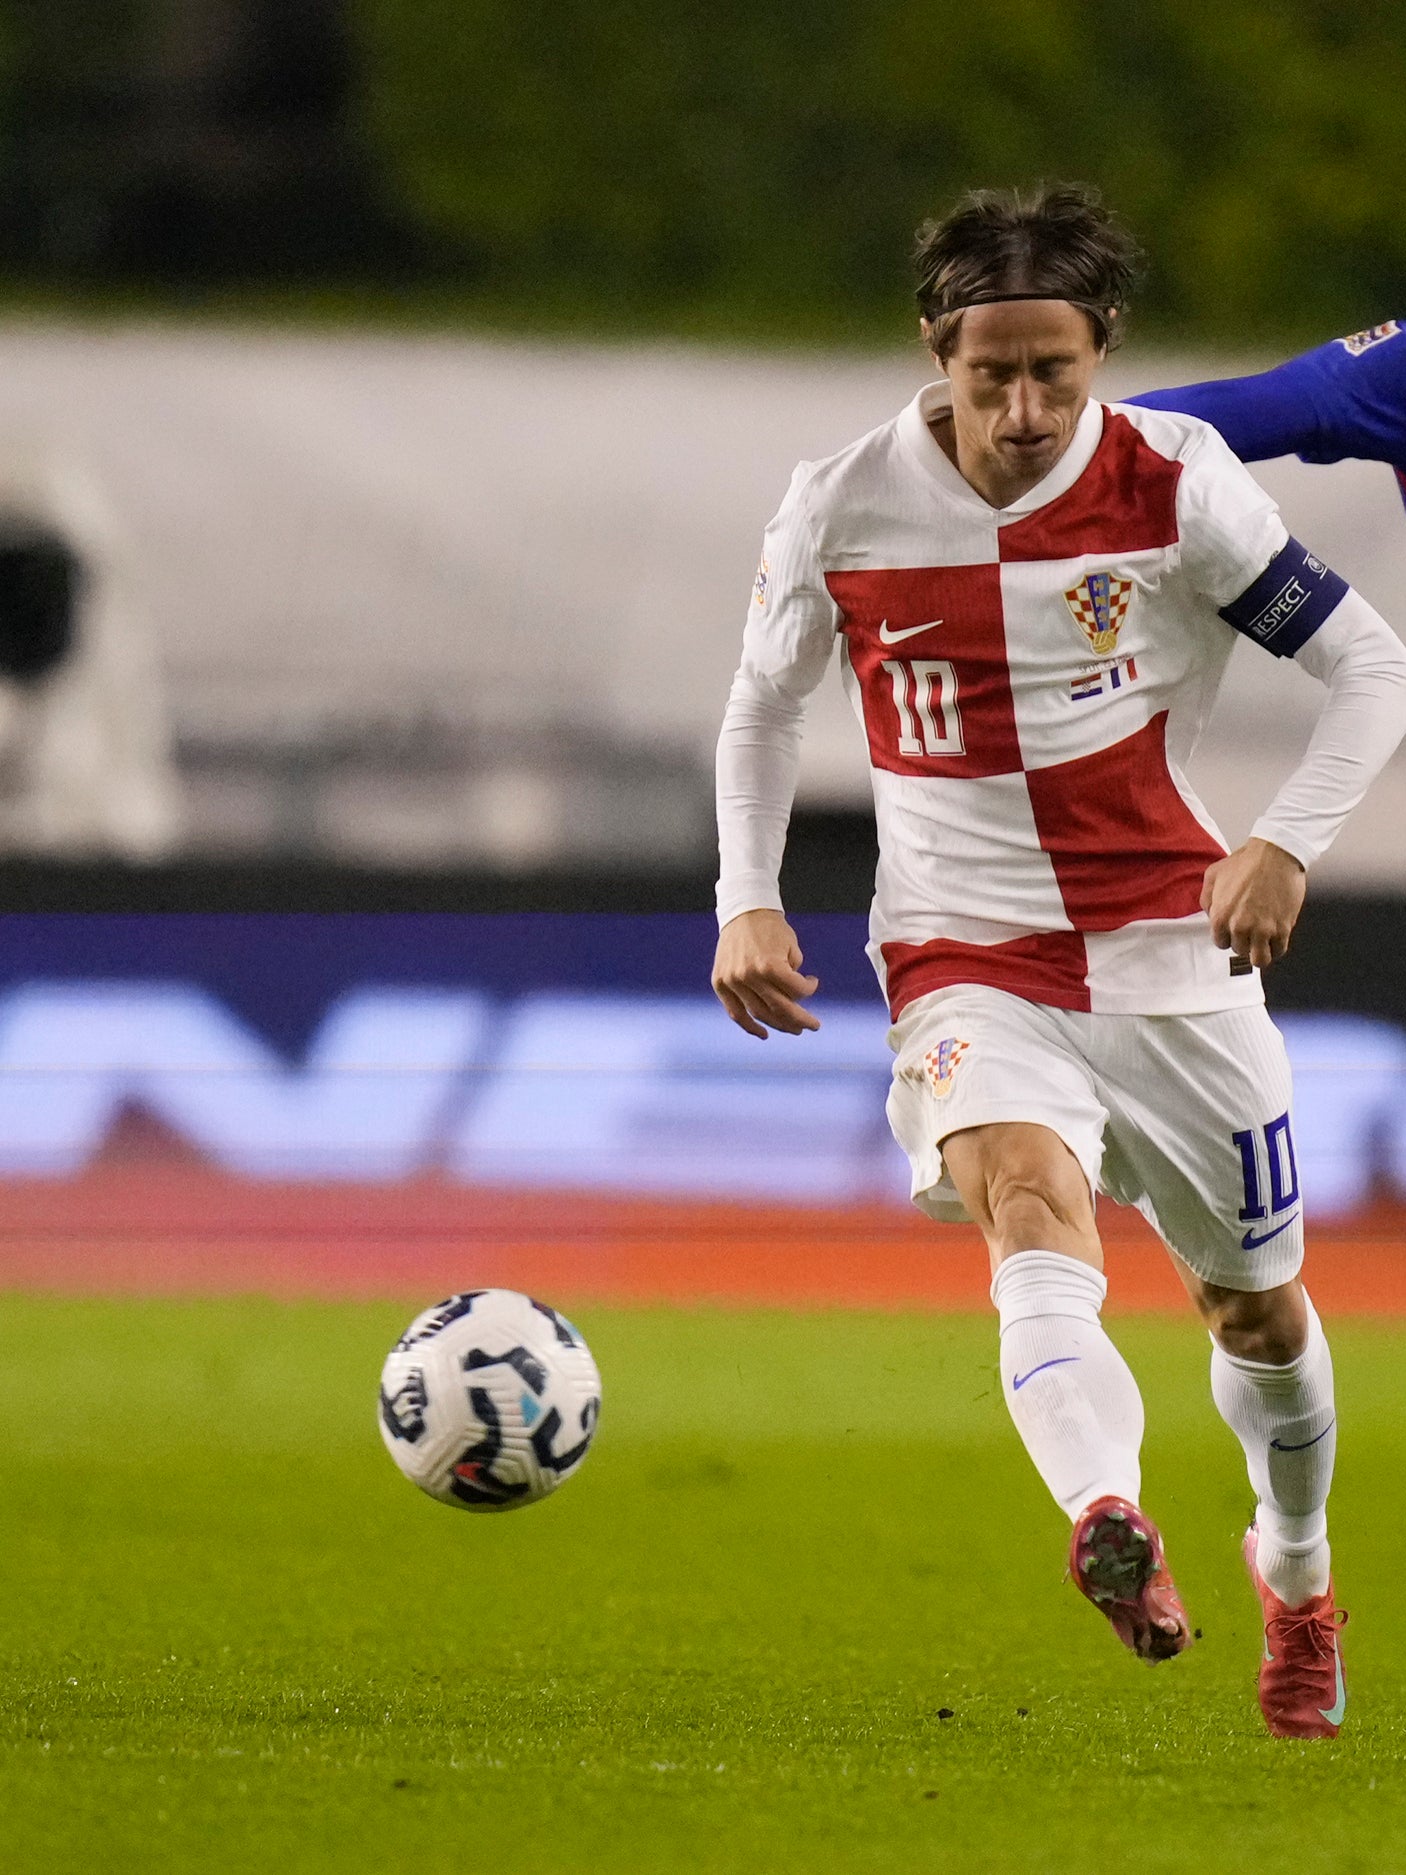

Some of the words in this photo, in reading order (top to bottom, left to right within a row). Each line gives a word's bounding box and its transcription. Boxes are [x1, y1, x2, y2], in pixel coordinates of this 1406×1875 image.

[1251, 579, 1306, 638] RESPECT
[880, 659, 967, 757] 10
[1231, 1110, 1300, 1223] 10
